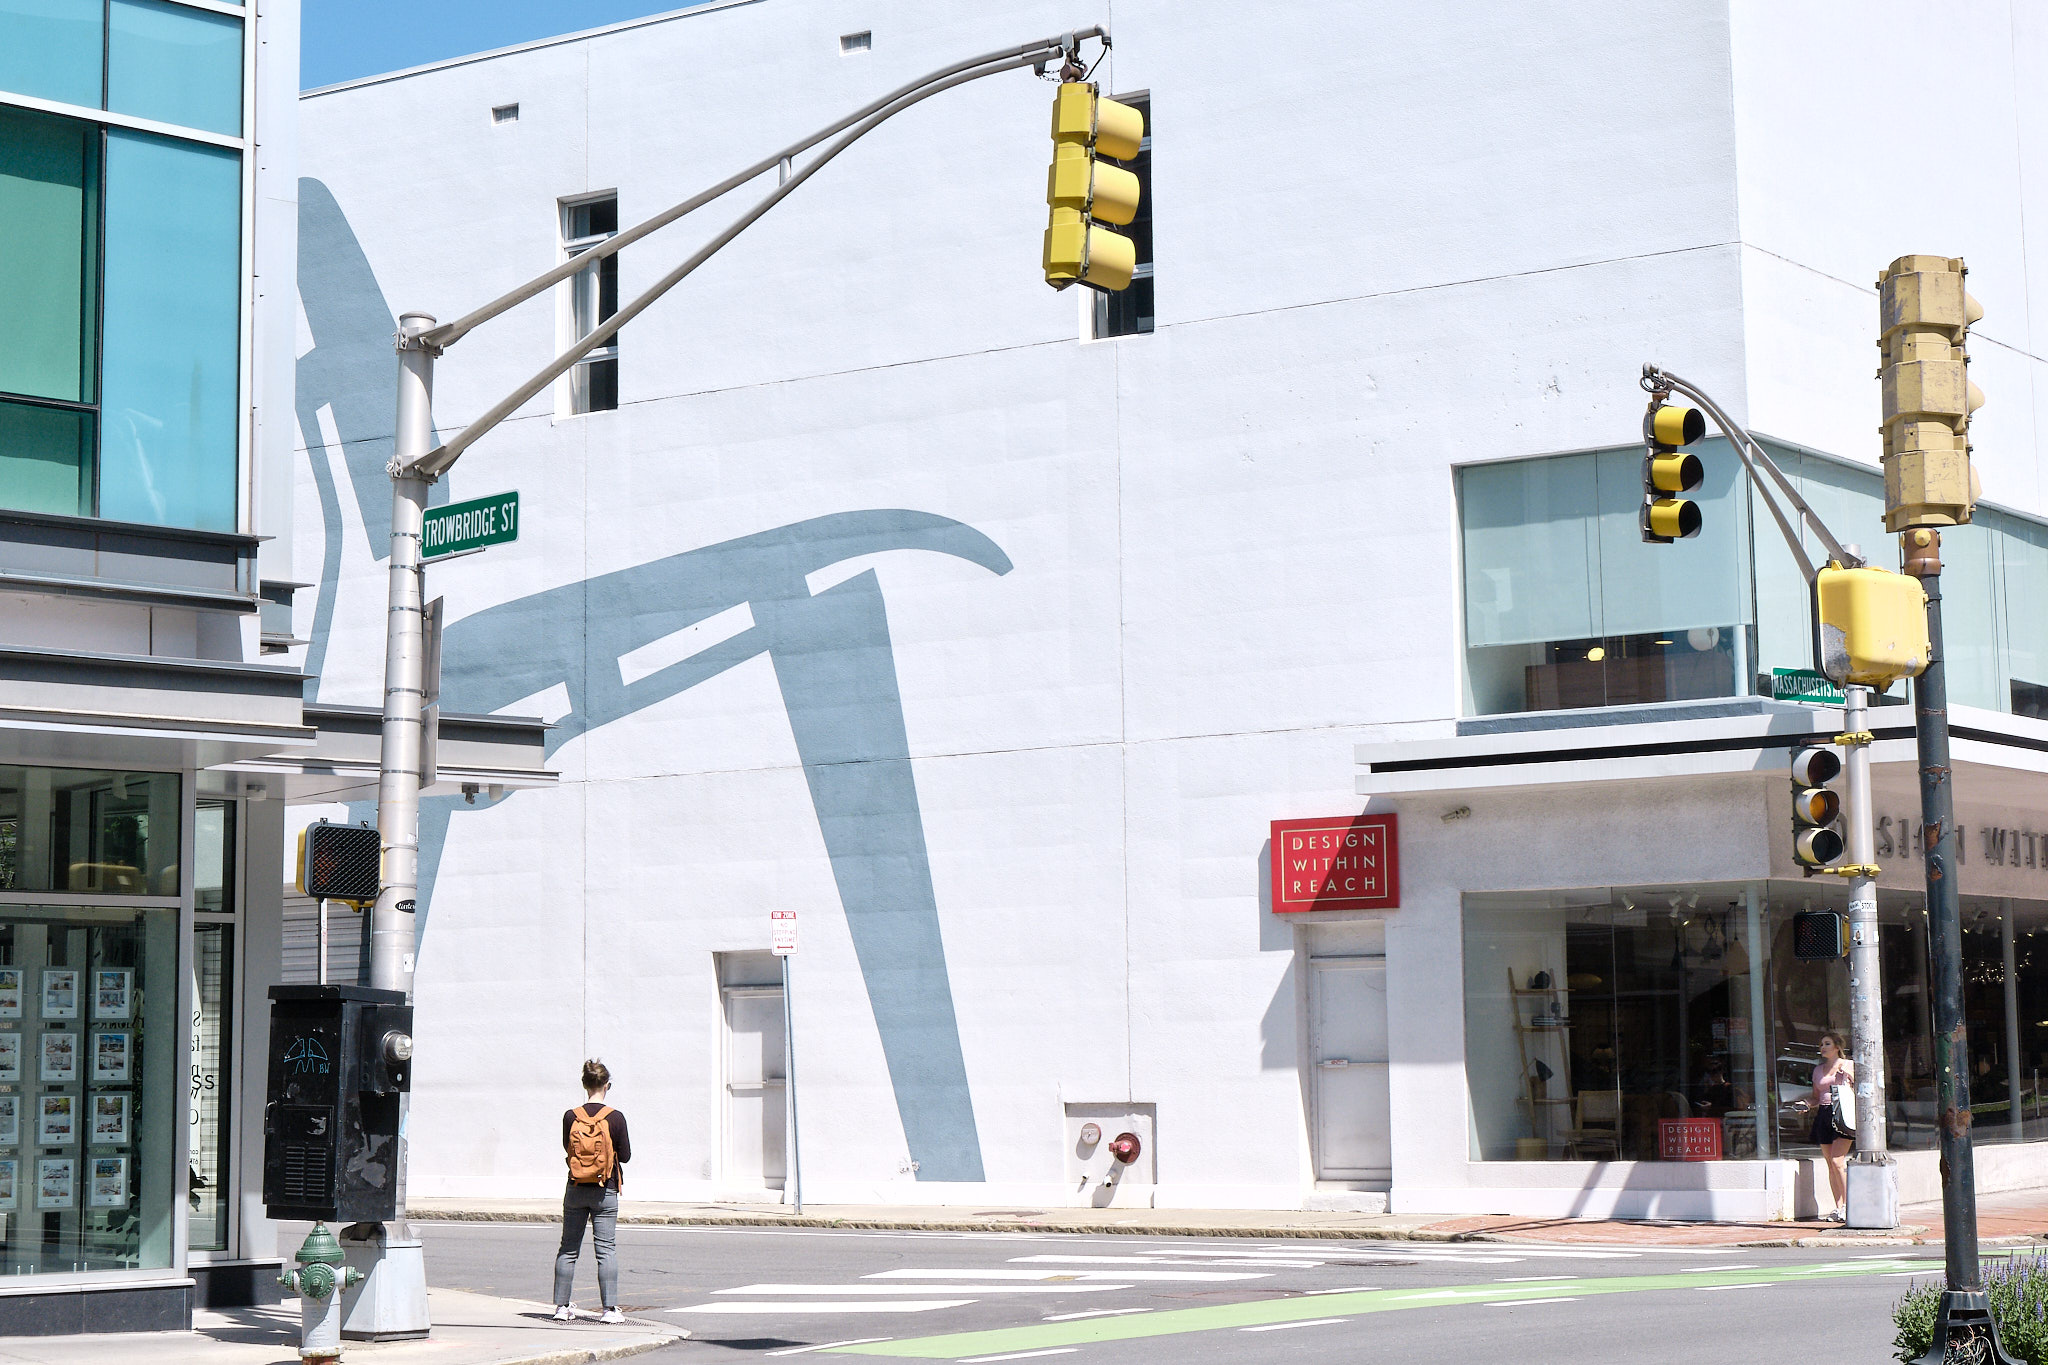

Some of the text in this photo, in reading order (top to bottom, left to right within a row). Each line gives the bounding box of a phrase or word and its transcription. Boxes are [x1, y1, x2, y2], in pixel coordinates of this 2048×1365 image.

[425, 502, 516, 548] TROWBRIDGE ST
[1773, 674, 1831, 698] MASSACHUSETTS
[1292, 832, 1375, 850] DESIGN
[1293, 855, 1375, 871] WITHIN
[1293, 876, 1375, 893] REACH
